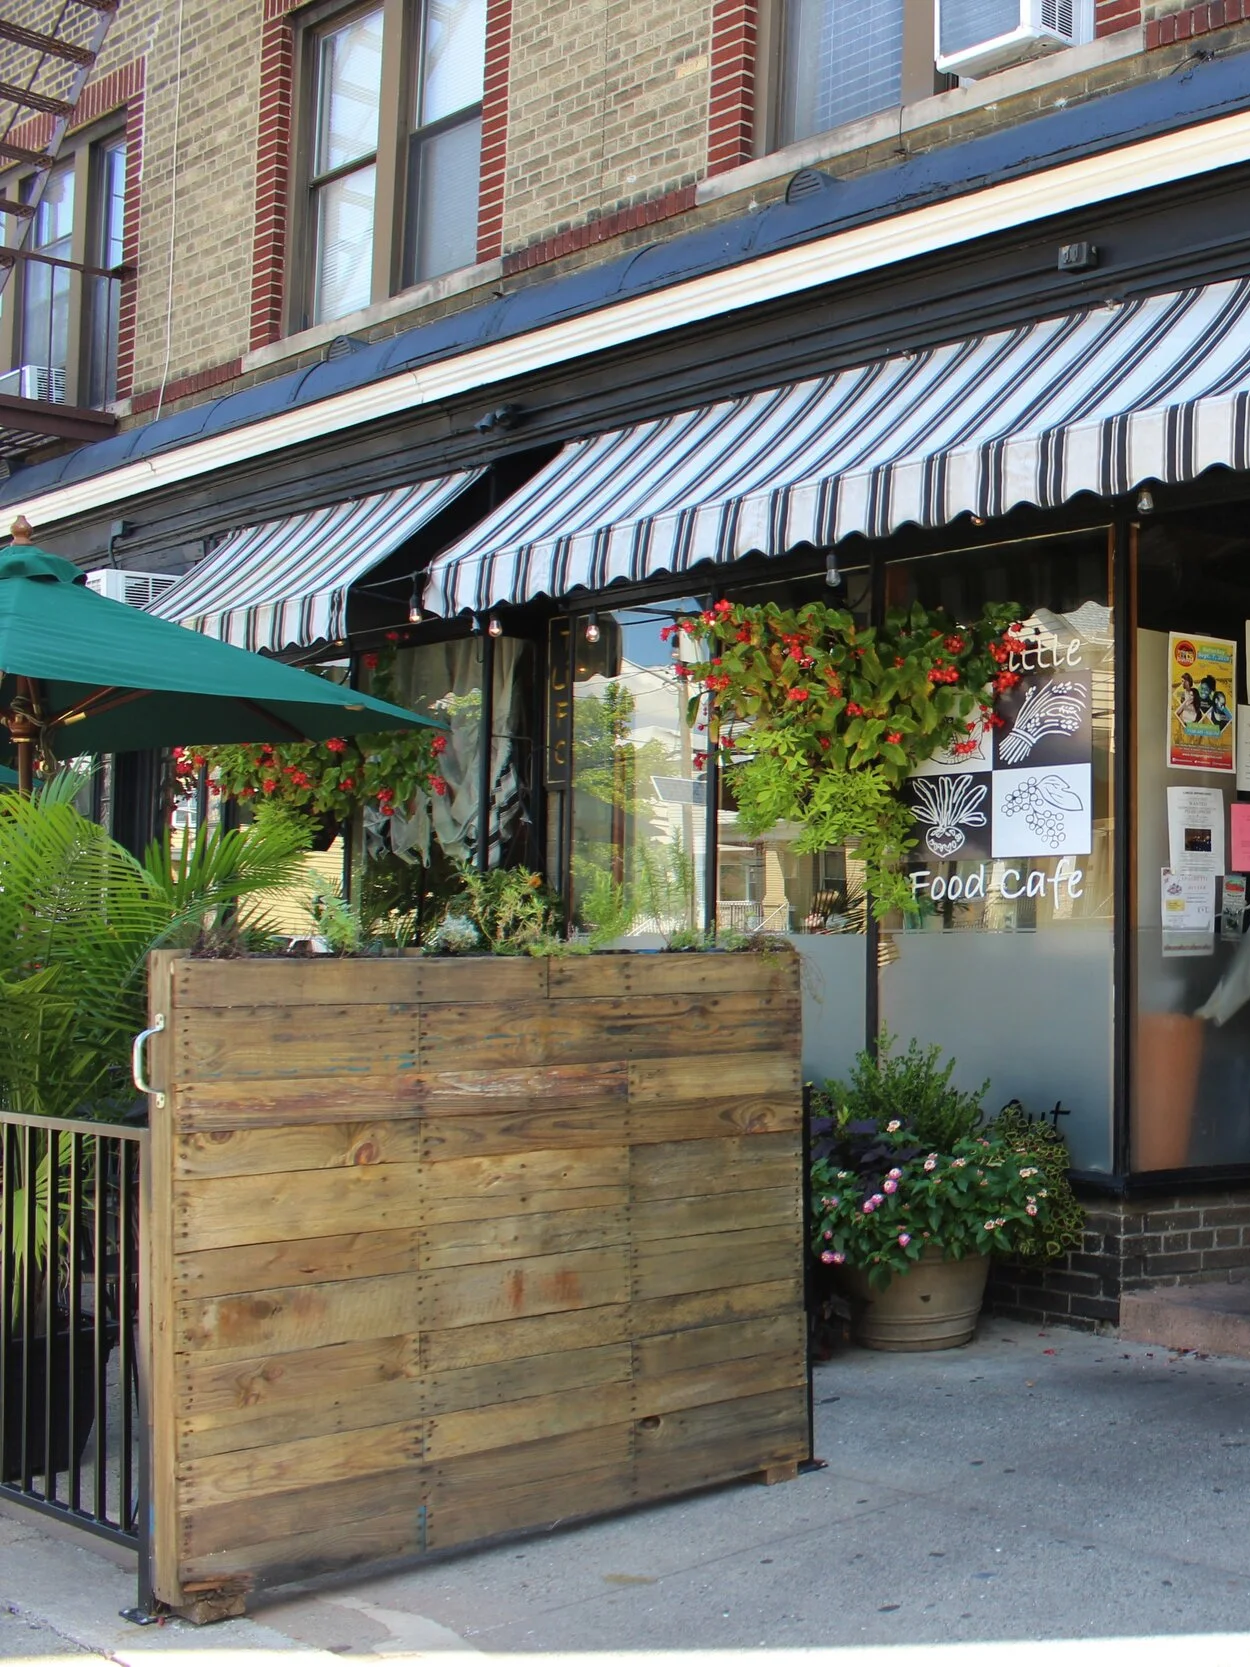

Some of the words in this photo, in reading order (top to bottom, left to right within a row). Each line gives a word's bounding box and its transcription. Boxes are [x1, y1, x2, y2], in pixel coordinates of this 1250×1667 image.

[1008, 633, 1082, 673] ittle
[909, 863, 986, 901] Food
[1000, 858, 1083, 910] Cafe
